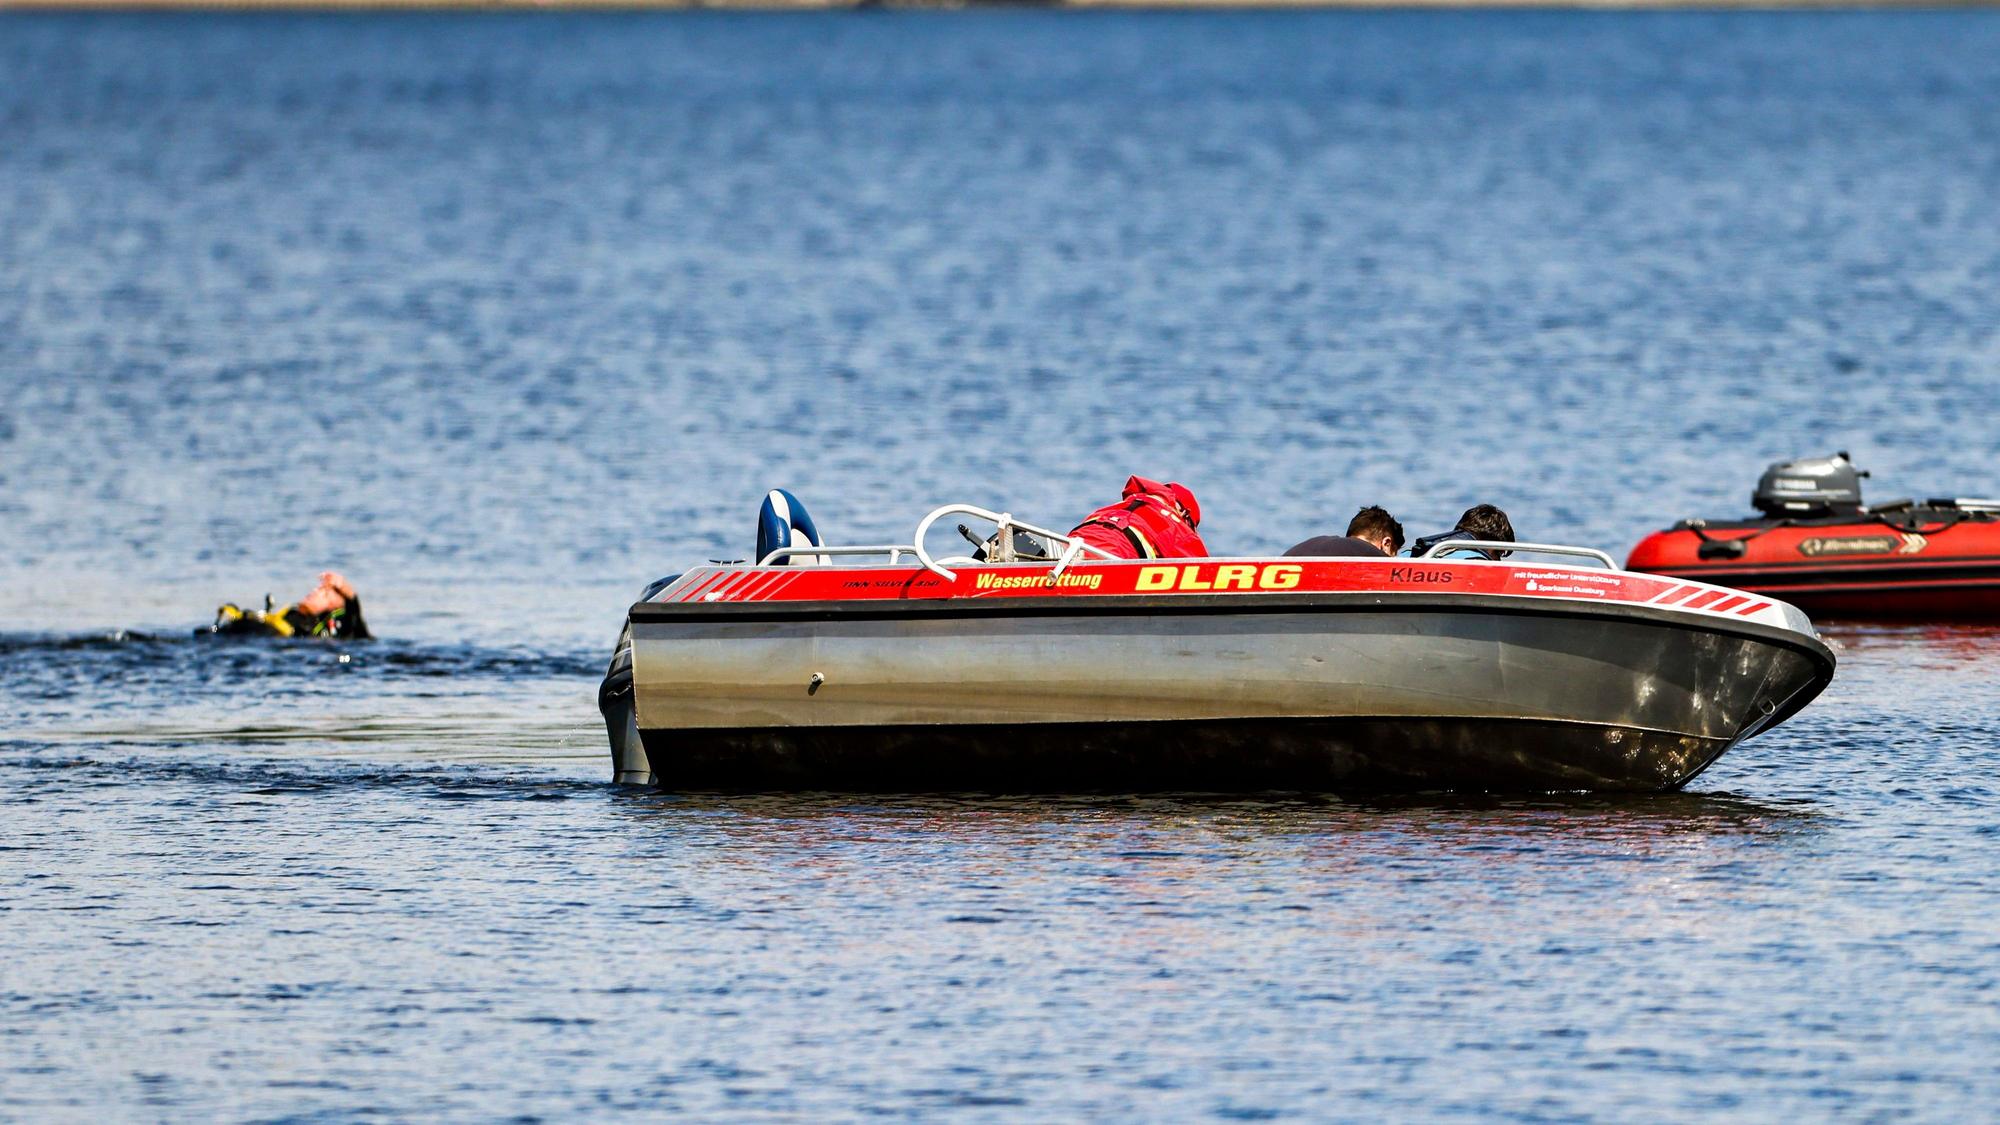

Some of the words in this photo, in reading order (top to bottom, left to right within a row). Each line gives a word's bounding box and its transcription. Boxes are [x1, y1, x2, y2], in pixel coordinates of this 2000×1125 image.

[1135, 565, 1303, 590] DLRG
[1390, 567, 1453, 583] Klaus
[1527, 572, 1569, 580] freundlicher
